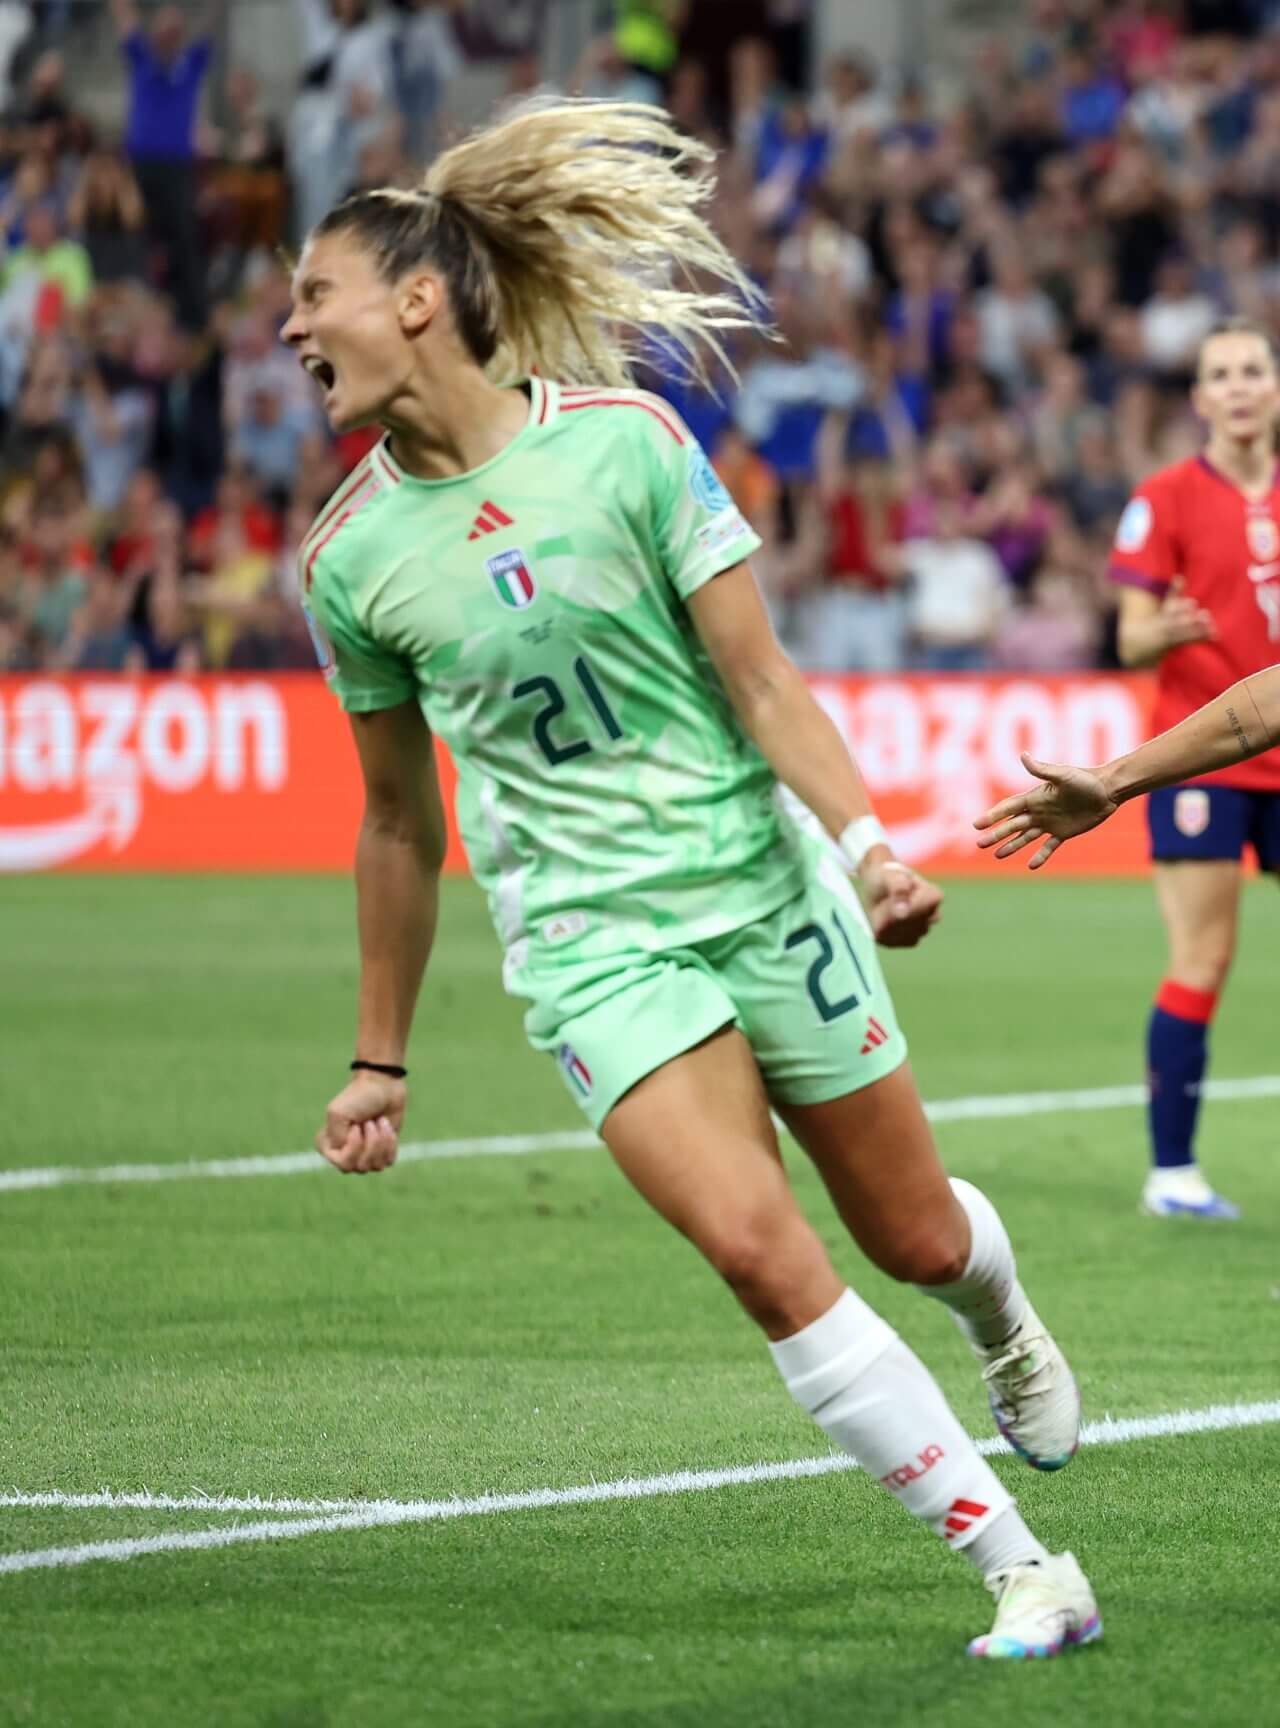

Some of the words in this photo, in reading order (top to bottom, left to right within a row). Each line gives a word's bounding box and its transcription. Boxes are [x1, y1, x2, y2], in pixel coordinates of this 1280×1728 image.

[0, 682, 287, 792] azon
[511, 655, 623, 767] 21
[785, 908, 871, 1023] 21
